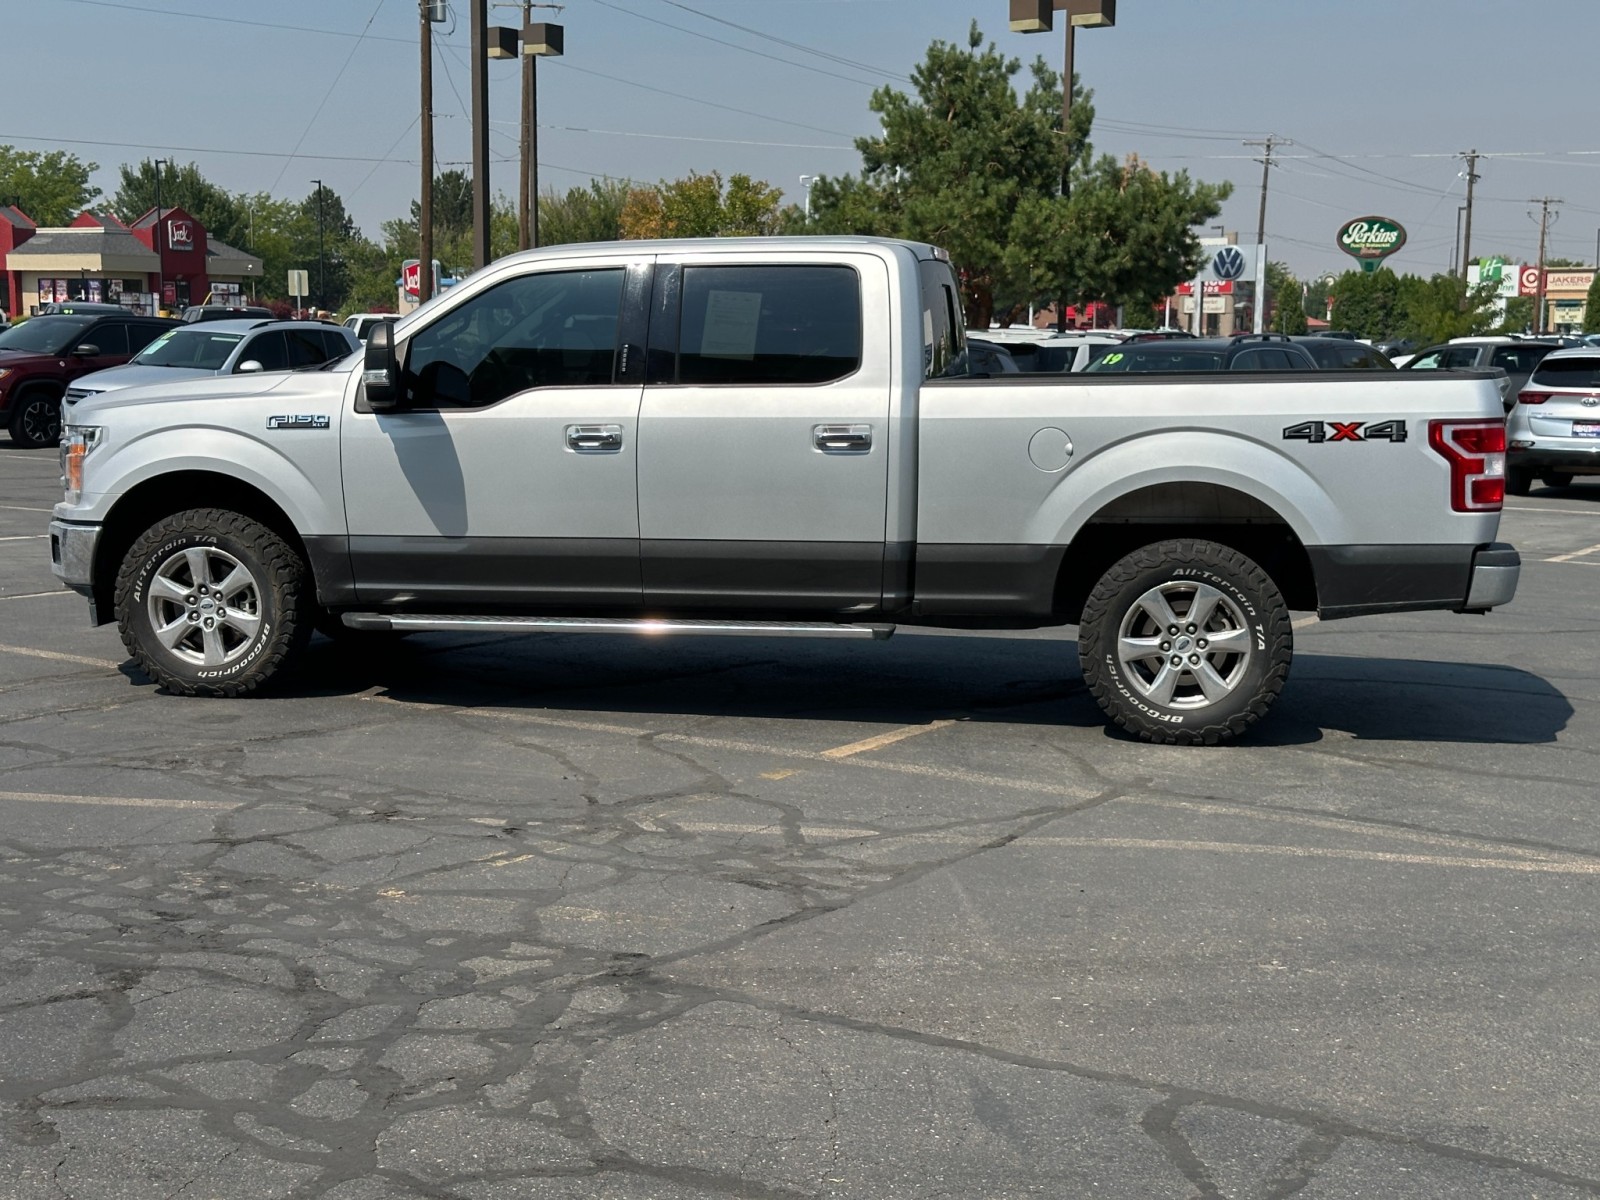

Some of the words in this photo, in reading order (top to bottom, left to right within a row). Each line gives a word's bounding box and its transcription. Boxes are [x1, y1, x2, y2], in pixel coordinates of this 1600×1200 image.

[172, 224, 193, 242] Jack
[1342, 222, 1399, 244] Perkins
[1549, 276, 1592, 284] JAKERS
[1101, 353, 1124, 365] 19
[193, 535, 218, 544] T/A
[1254, 623, 1266, 650] T/A
[197, 623, 271, 679] BFGoodrich
[1106, 654, 1184, 723] BFGoodrich
